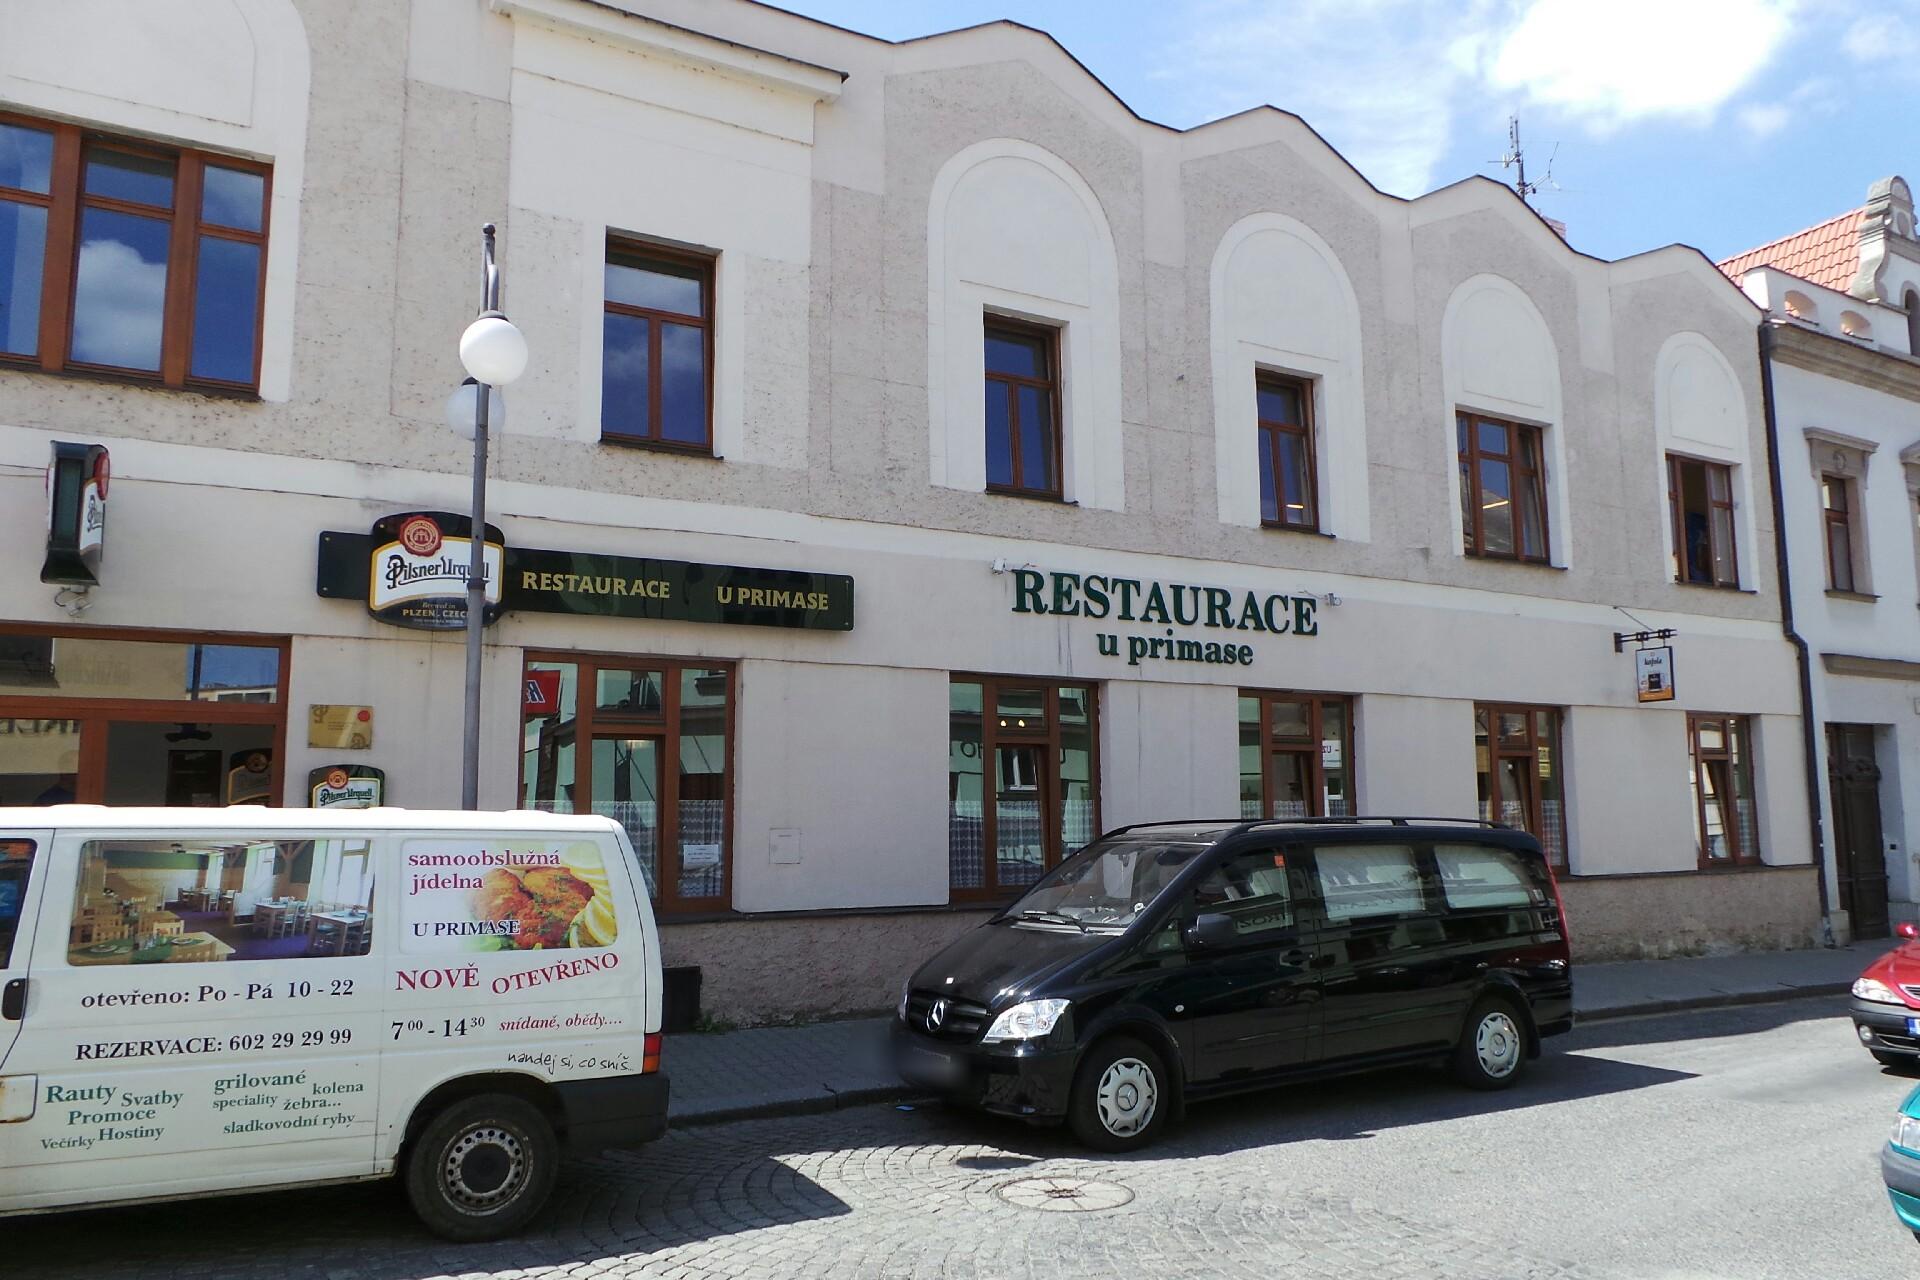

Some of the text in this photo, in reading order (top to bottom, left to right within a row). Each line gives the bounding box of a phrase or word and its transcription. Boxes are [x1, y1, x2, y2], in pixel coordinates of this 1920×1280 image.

[386, 555, 490, 590] Pilsner Urqul
[523, 571, 671, 599] RESTAURACE
[717, 586, 829, 611] U PRIMASE
[1011, 569, 1318, 636] RESTAURACE
[442, 609, 469, 618] CZEC
[1097, 628, 1255, 666] u primase
[320, 788, 347, 806] Pilsner
[408, 849, 561, 867] samoobslužná
[409, 872, 484, 896] jídelna
[412, 920, 520, 937] U PRIMASE
[395, 952, 620, 995] NOVĚ OTEVŘENO
[81, 989, 190, 1008] otevřeno:
[197, 985, 227, 1002] Po
[246, 982, 274, 1000] Pá
[287, 981, 311, 998] 10
[330, 979, 354, 996] 22
[499, 1015, 560, 1031] snídaně,
[75, 1028, 353, 1060] REZERVACE: 602 29 29 99
[578, 1058, 596, 1069] co
[214, 1069, 306, 1095] grilované
[312, 1081, 364, 1095] kolena
[45, 1084, 117, 1105] Rauty
[121, 1090, 184, 1109] Svatby
[212, 1093, 278, 1112] speciality
[67, 1109, 156, 1126] Promoce
[223, 1112, 355, 1134] sladkovodní ryby
[41, 1134, 96, 1150] Večírky
[98, 1125, 165, 1142] Hostiny
